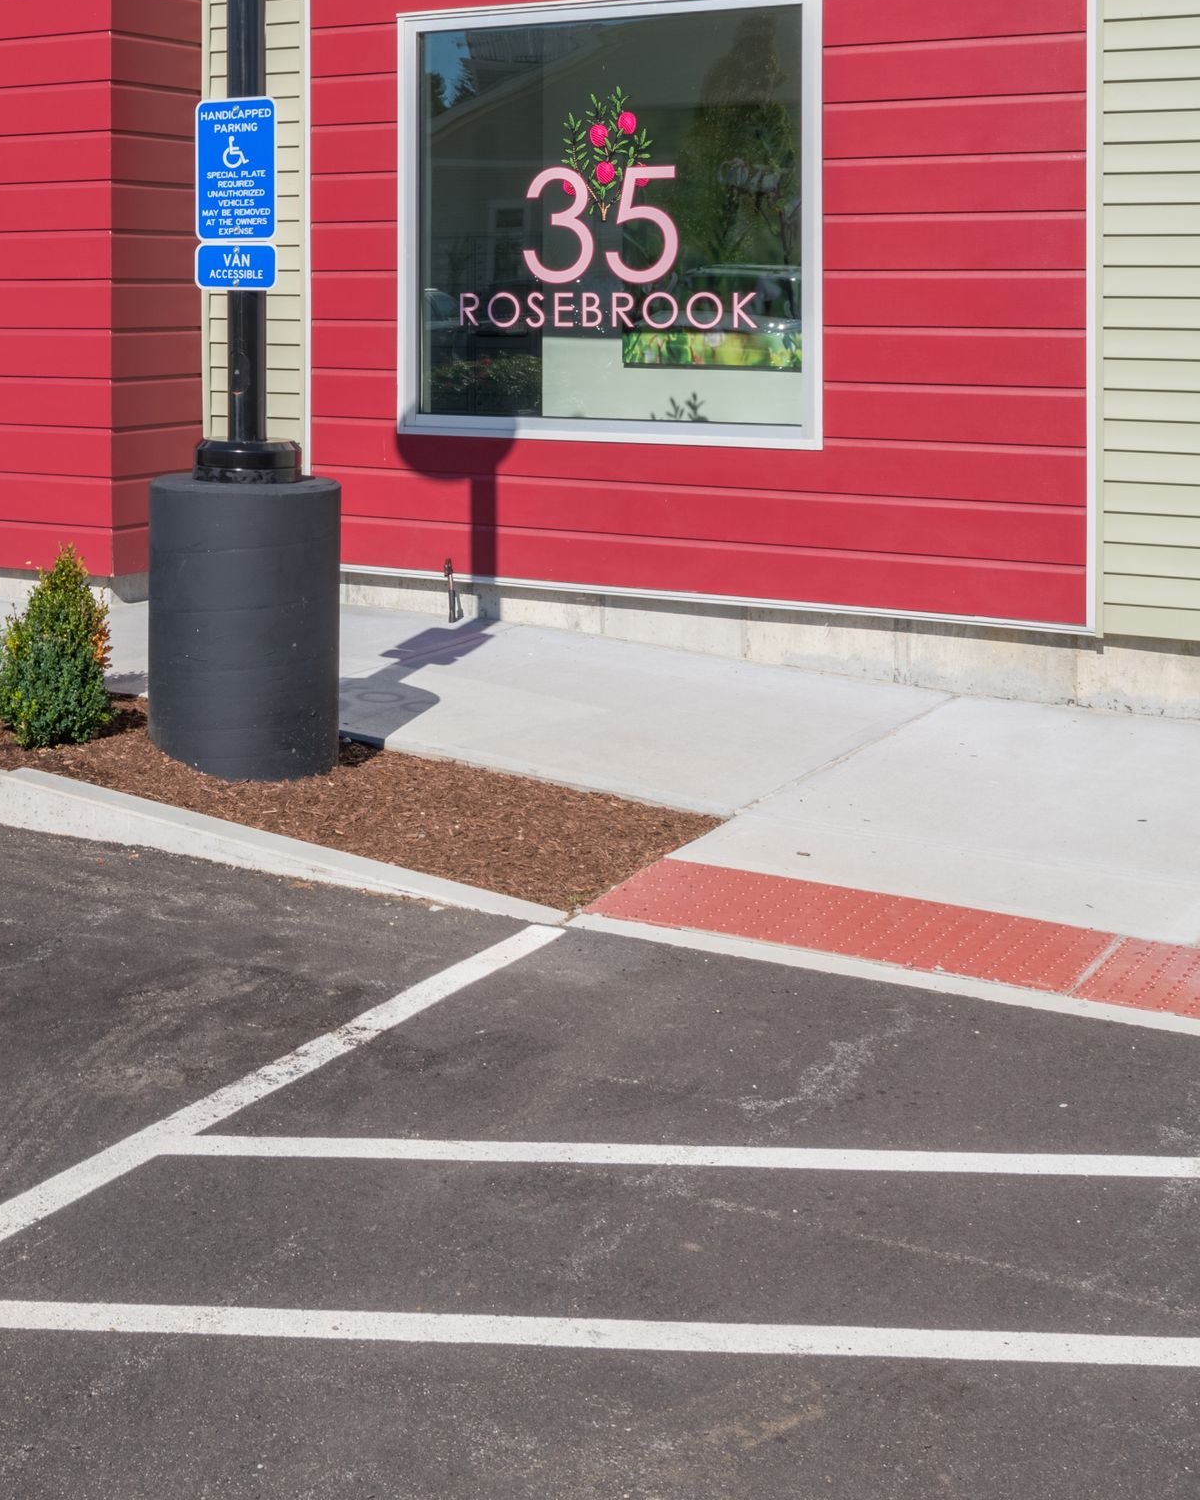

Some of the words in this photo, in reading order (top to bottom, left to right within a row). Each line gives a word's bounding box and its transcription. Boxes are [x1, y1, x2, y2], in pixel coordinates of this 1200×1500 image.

[200, 108, 272, 121] HANDICAPPED
[213, 122, 258, 134] PARKING
[206, 171, 238, 179] SPECIAL
[240, 169, 266, 178] PLATE
[217, 179, 255, 188] REQUIRED
[207, 189, 265, 198] UNAUTHORIZED
[218, 198, 255, 207] VEHICLES
[202, 209, 219, 217] MAY
[221, 208, 232, 216] BE
[234, 207, 271, 216] REMOVED
[205, 218, 216, 226] AT
[235, 217, 268, 225] OWNERS
[522, 165, 679, 284] 35
[223, 253, 251, 267] VAN
[209, 269, 264, 279] ACCESSIBLE
[459, 291, 758, 329] ROSEBROOK
